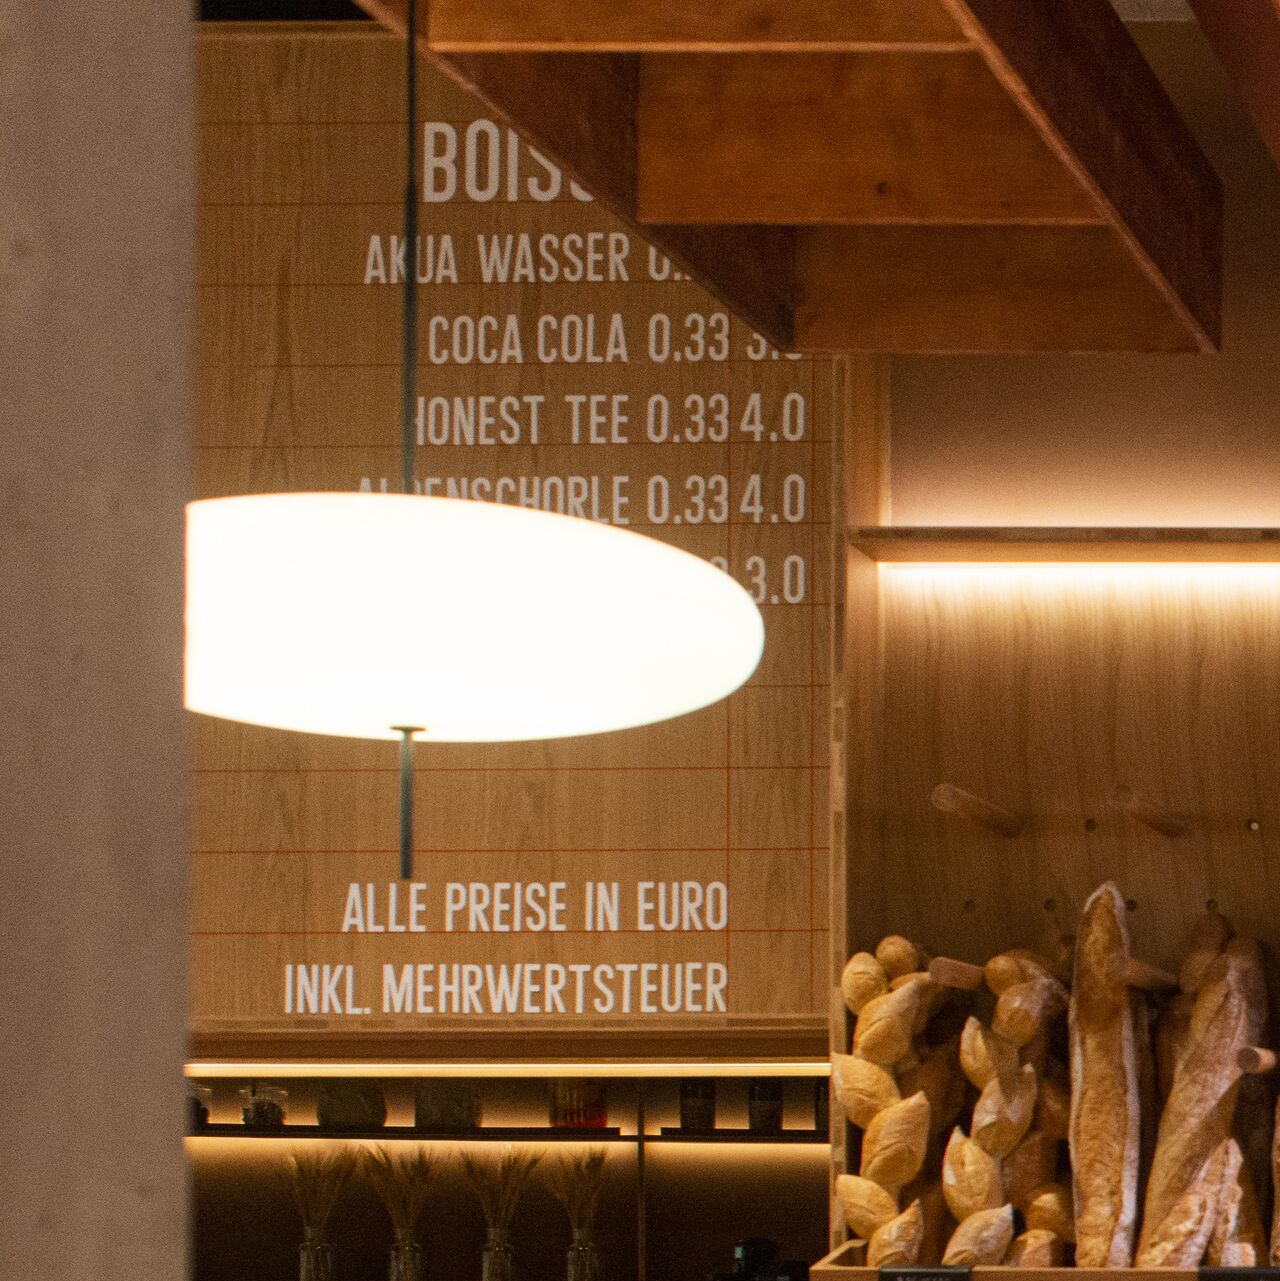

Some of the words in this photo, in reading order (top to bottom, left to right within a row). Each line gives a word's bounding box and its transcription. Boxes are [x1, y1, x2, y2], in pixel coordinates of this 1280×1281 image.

[423, 118, 594, 203] BOIS
[477, 232, 630, 283] WASSER
[427, 314, 524, 365] COCA
[536, 313, 629, 364] COLA
[648, 312, 730, 363] 0.33
[746, 332, 803, 361] 3.
[564, 394, 629, 445] TEE
[647, 393, 730, 443] 0.33
[740, 393, 805, 441] 4.0
[648, 474, 730, 525] 0.33
[740, 473, 805, 523] 4.0
[745, 555, 805, 604] 3.0
[341, 882, 427, 934] ALLE
[444, 881, 567, 933] PREISE
[584, 881, 620, 932] IN
[636, 880, 729, 932] EURO
[284, 963, 371, 1015] INKL.
[382, 962, 728, 1015] MEHRWERTSTEUER
